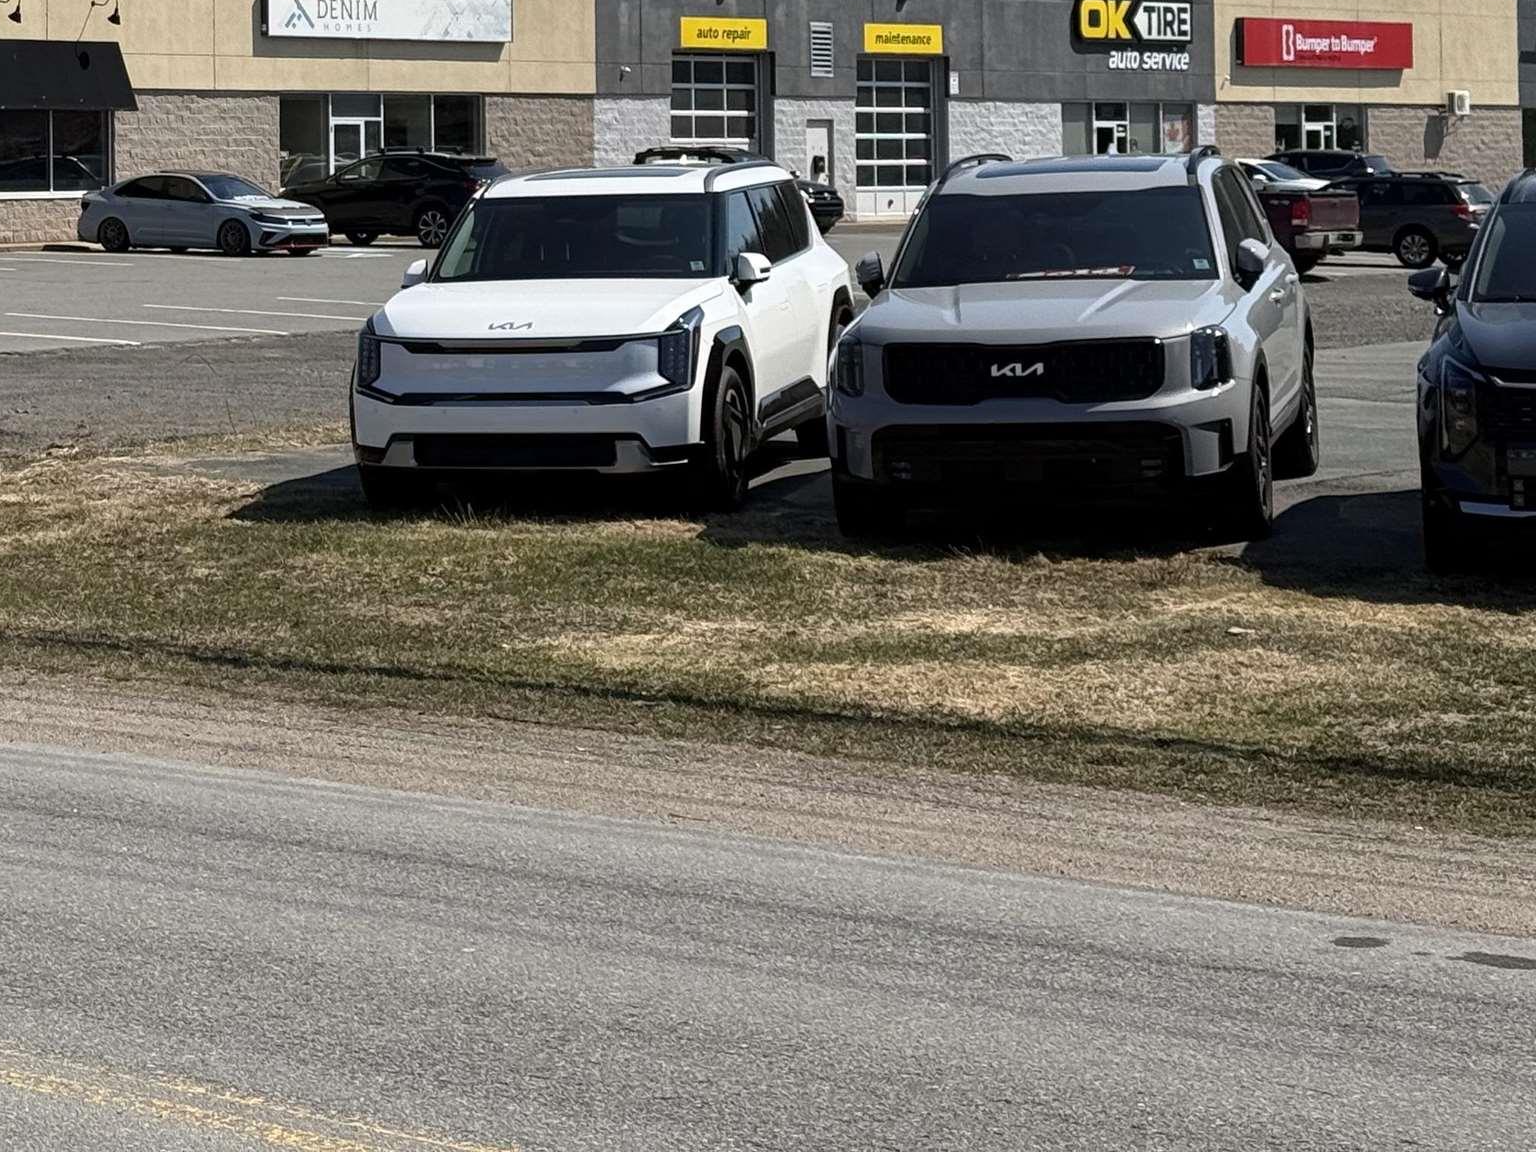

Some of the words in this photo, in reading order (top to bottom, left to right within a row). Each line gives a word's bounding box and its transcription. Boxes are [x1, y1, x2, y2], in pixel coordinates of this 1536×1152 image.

[323, 23, 373, 32] HOMES
[1143, 6, 1189, 37] TIRE
[696, 27, 719, 39] auto
[721, 26, 752, 43] repair
[875, 34, 932, 46] maintenance
[1296, 33, 1330, 55] Bumper
[1331, 36, 1340, 51] to
[1341, 34, 1375, 55] Bumper
[1109, 50, 1140, 69] auto
[1142, 48, 1190, 70] service
[990, 362, 1044, 376] KIA
